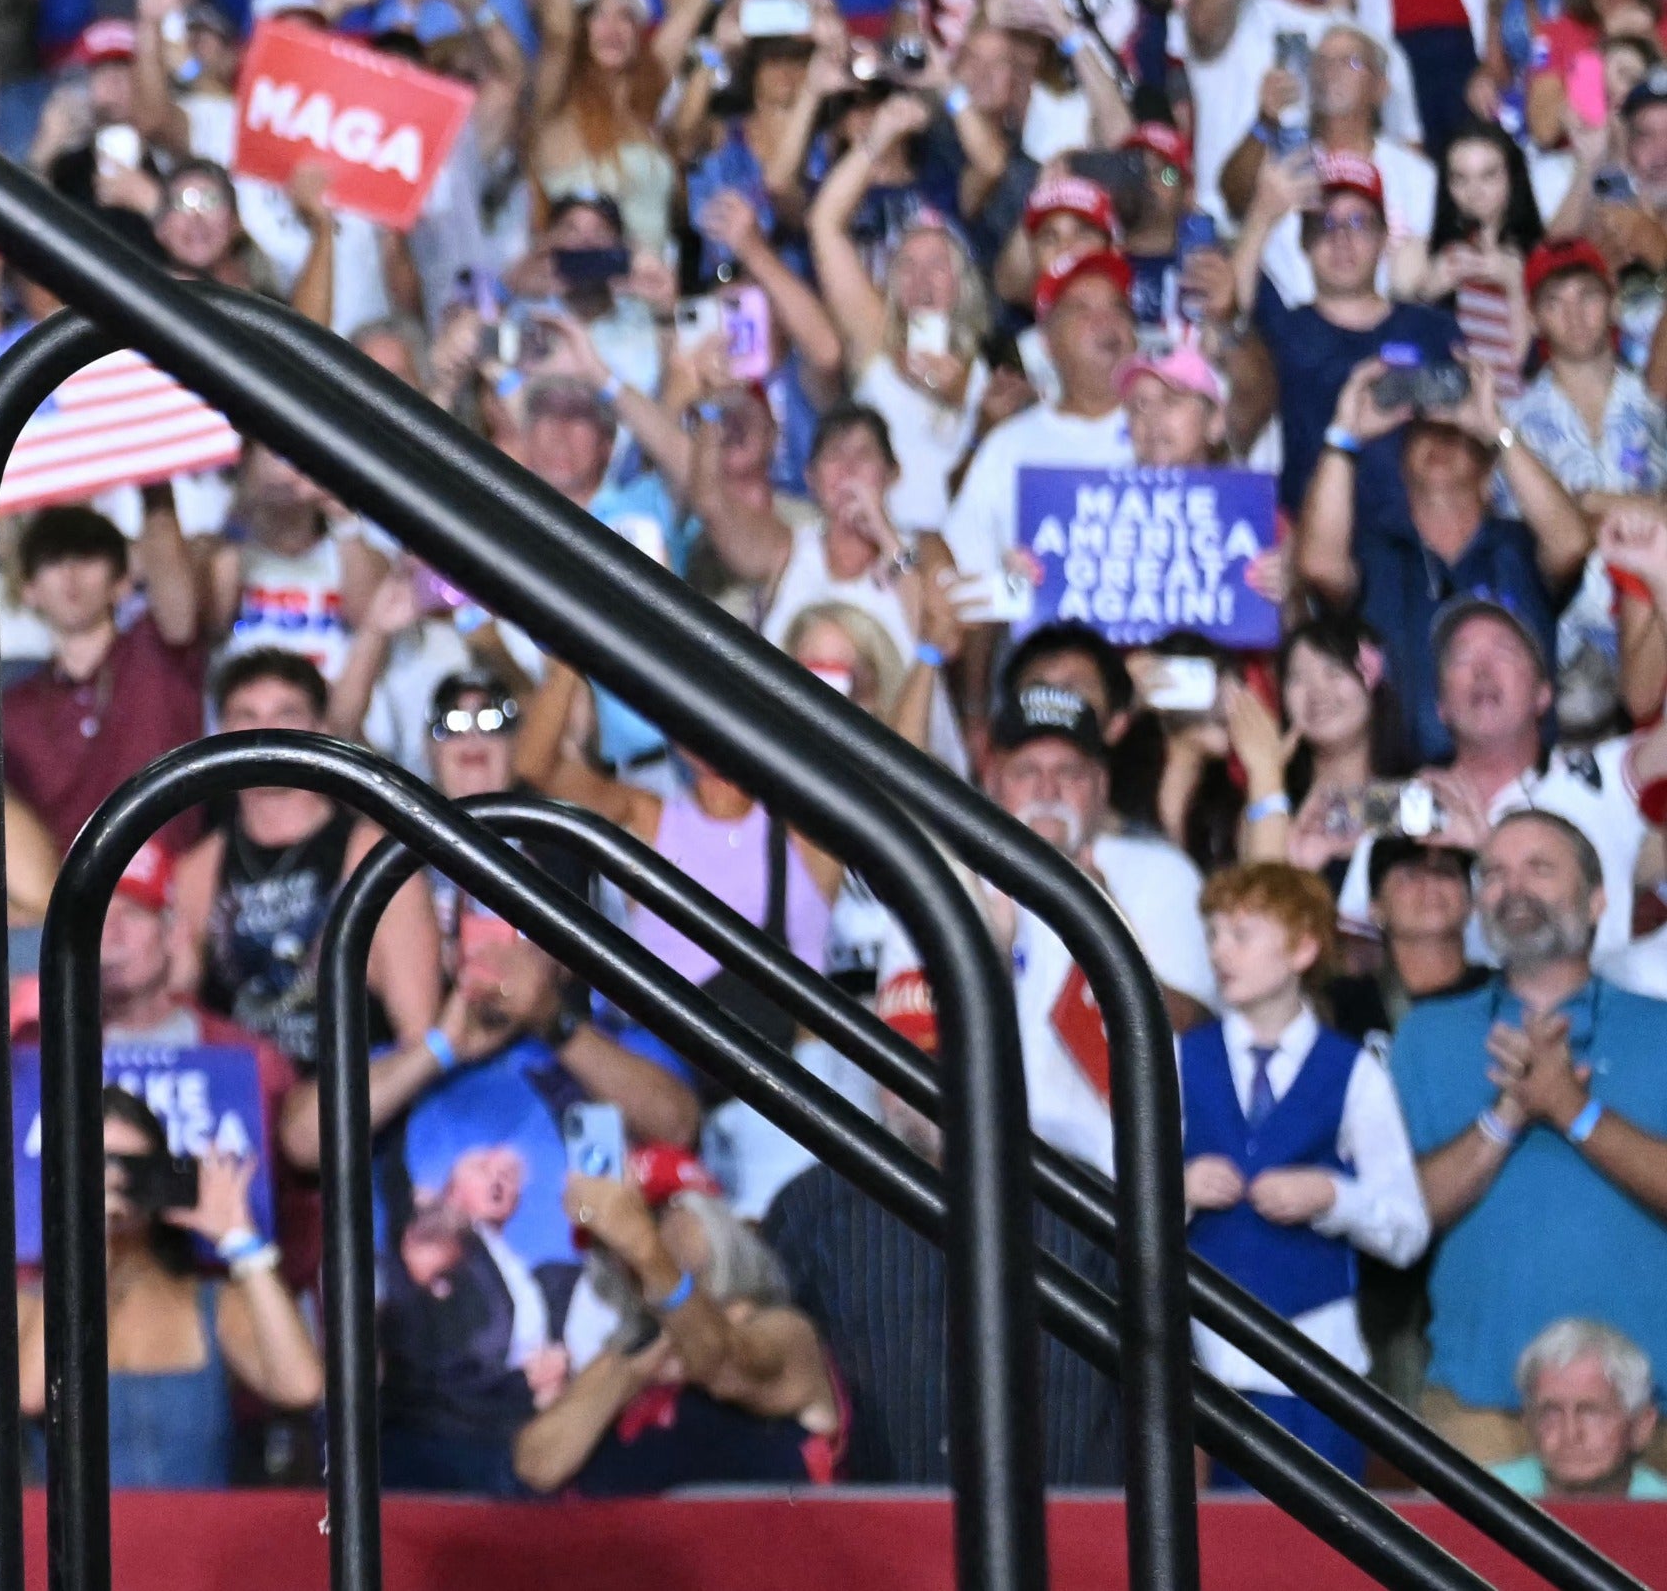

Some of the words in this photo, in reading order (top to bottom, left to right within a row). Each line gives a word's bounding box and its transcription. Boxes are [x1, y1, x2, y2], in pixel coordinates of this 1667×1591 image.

[245, 74, 424, 184] MAGA
[1075, 484, 1217, 526] MAKE
[1032, 515, 1260, 560] AMERICA
[1064, 553, 1229, 592] GREAT
[1057, 583, 1236, 625] AGAIN!
